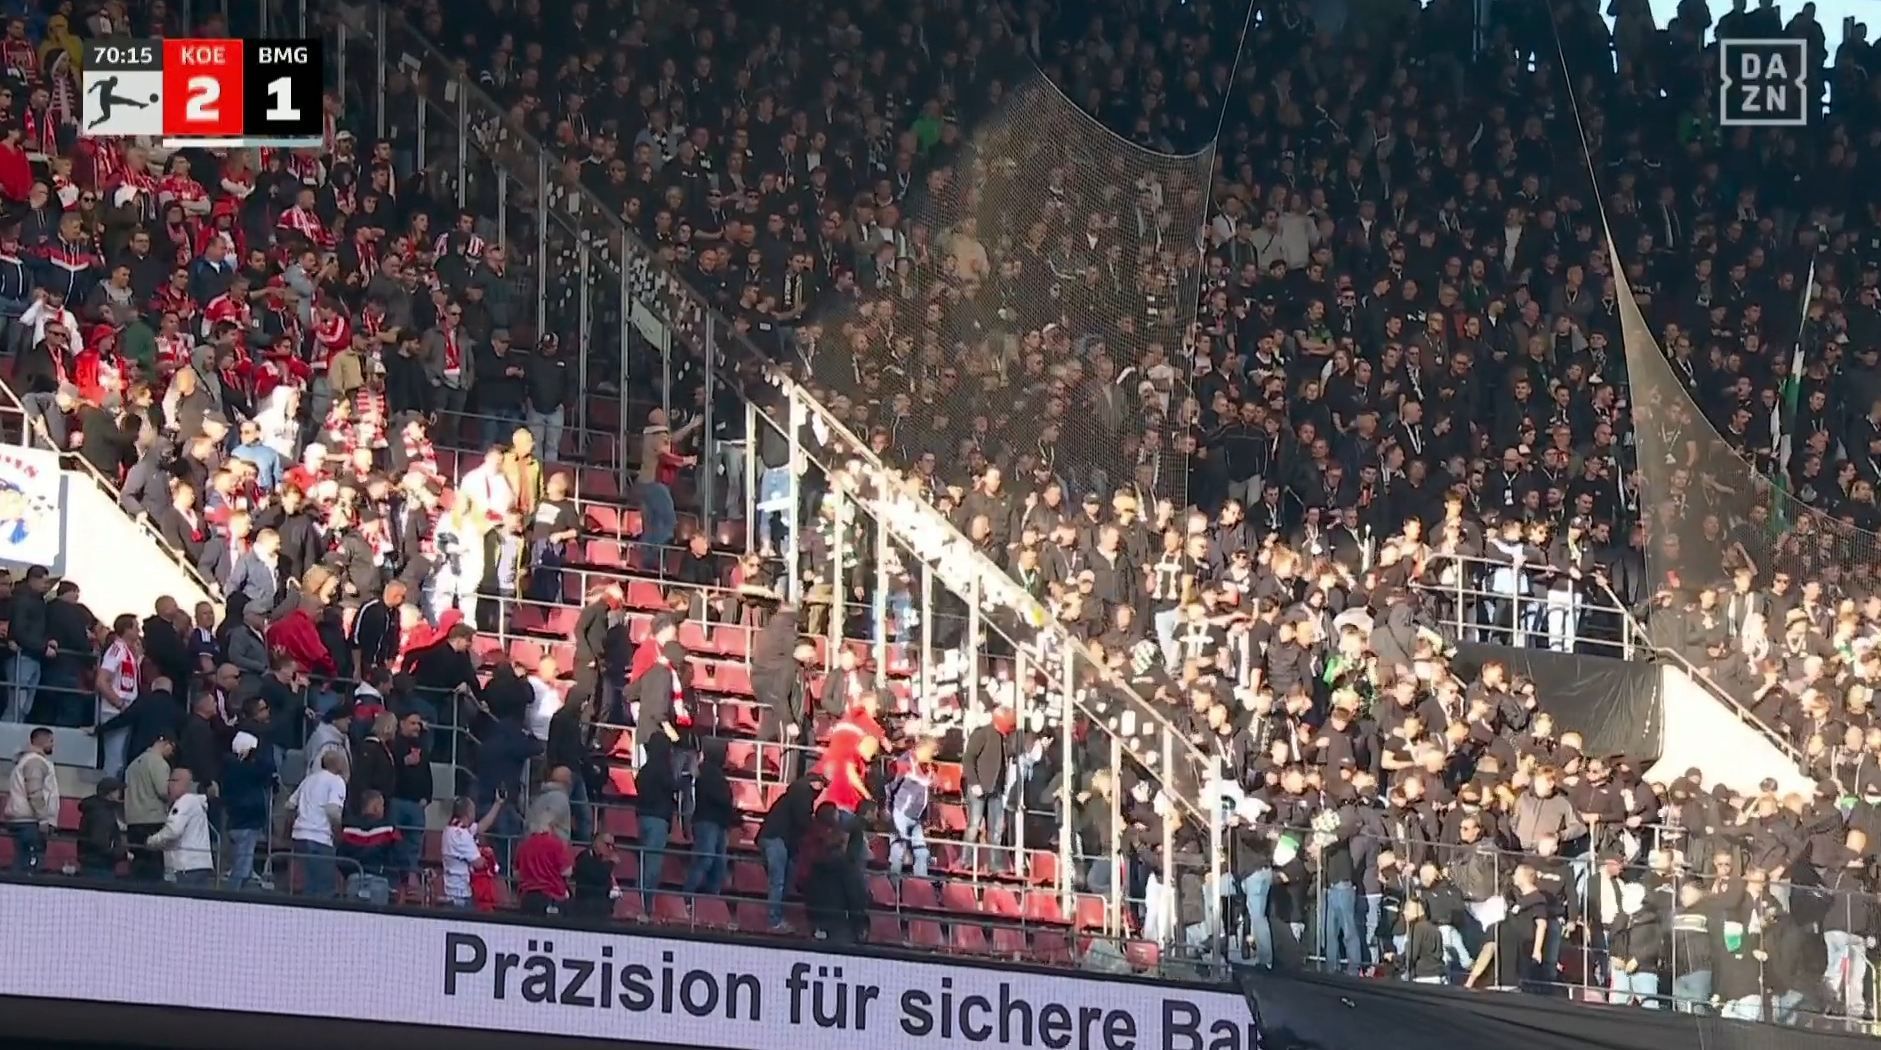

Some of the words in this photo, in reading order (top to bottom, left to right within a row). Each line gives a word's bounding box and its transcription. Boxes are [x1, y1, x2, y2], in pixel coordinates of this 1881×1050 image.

[443, 931, 762, 1022] Präzision
[785, 961, 880, 1030] für
[899, 976, 1137, 1050] sichere
